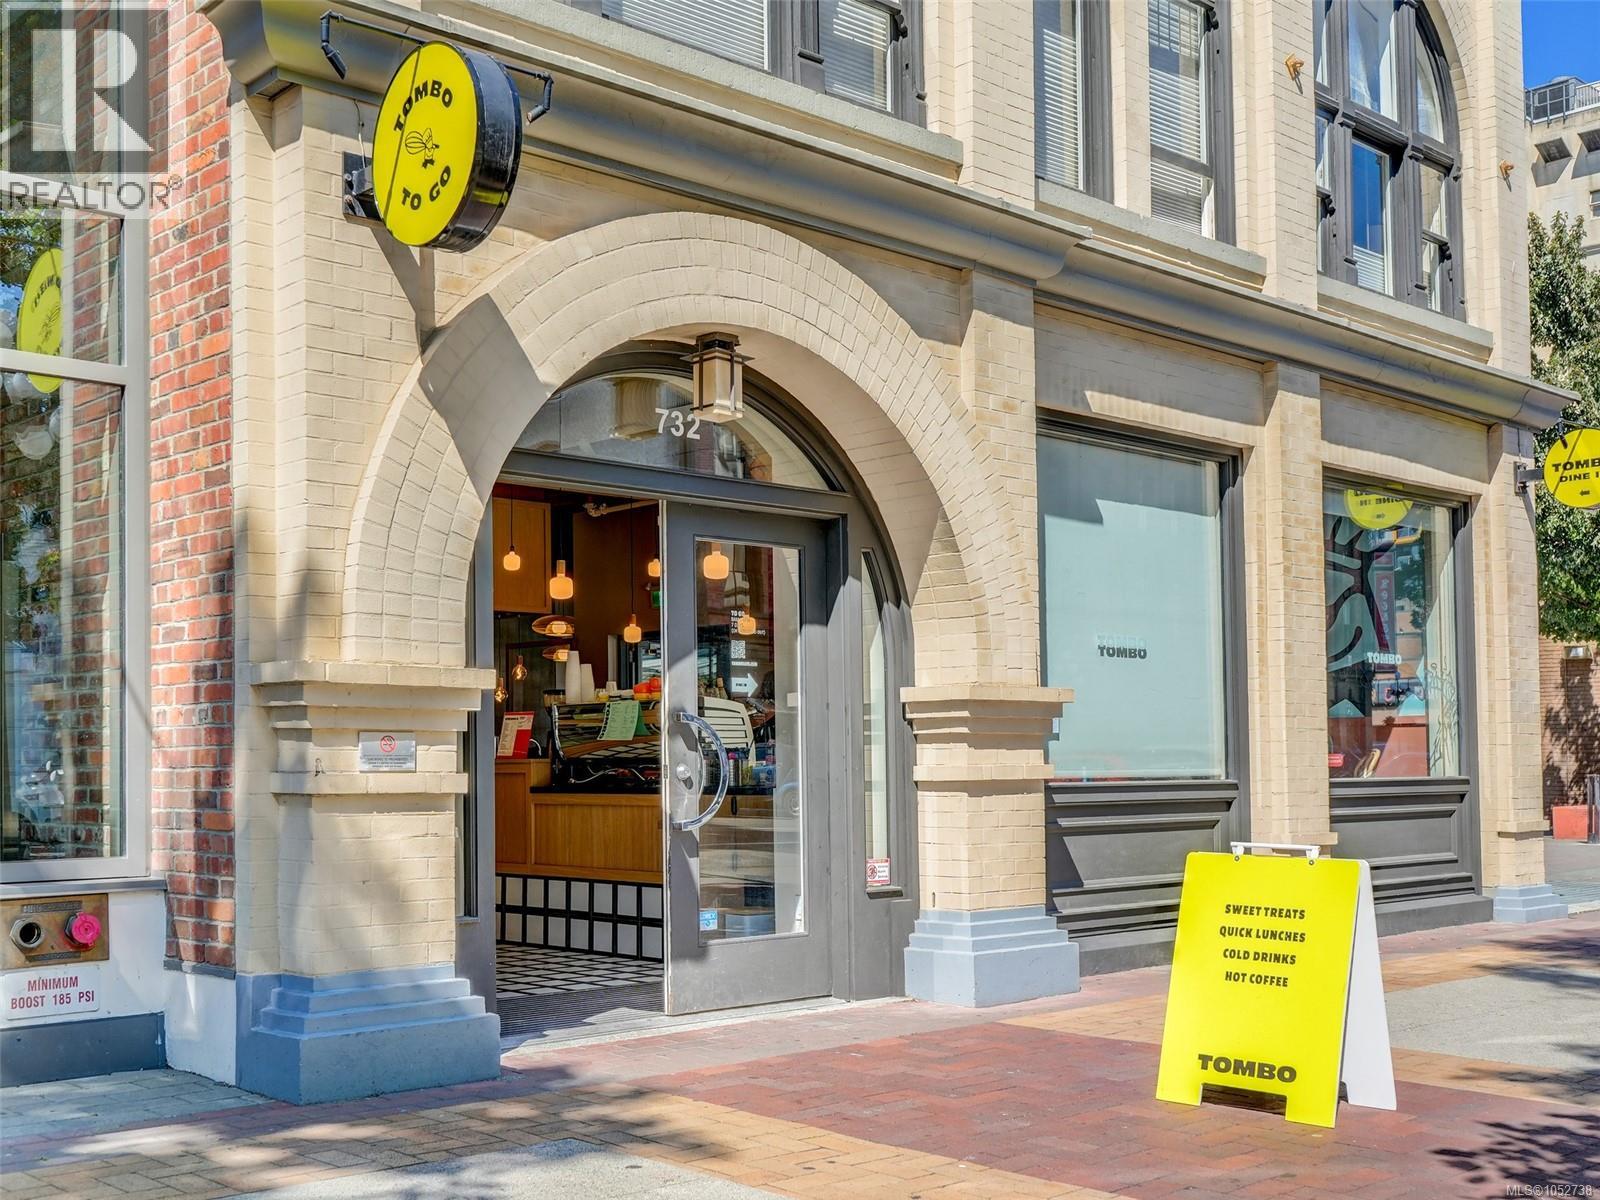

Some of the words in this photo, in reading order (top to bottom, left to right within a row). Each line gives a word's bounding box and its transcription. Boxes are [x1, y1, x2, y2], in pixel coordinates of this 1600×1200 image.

[393, 79, 454, 132] TOMBO
[401, 187, 422, 211] TO
[429, 165, 451, 202] GO
[655, 407, 701, 440] 732
[1559, 472, 1591, 483] DINE
[1097, 644, 1148, 660] TOMBO
[1366, 651, 1402, 665] TOMBO
[1224, 903, 1263, 918] SWEET
[1263, 905, 1306, 920] TREATS
[1219, 925, 1253, 939] QUICK
[1255, 927, 1306, 943] LUNCHES
[1222, 948, 1250, 961] COLD
[1252, 951, 1297, 965] DRINKS
[27, 975, 79, 992] MINIMUM
[1224, 971, 1247, 984] HOT
[1249, 973, 1289, 988] COFFEE
[10, 994, 46, 1010] BOOST
[52, 992, 72, 1006] 185
[78, 990, 95, 1003] PSI
[1197, 1053, 1298, 1084] TOMBO
